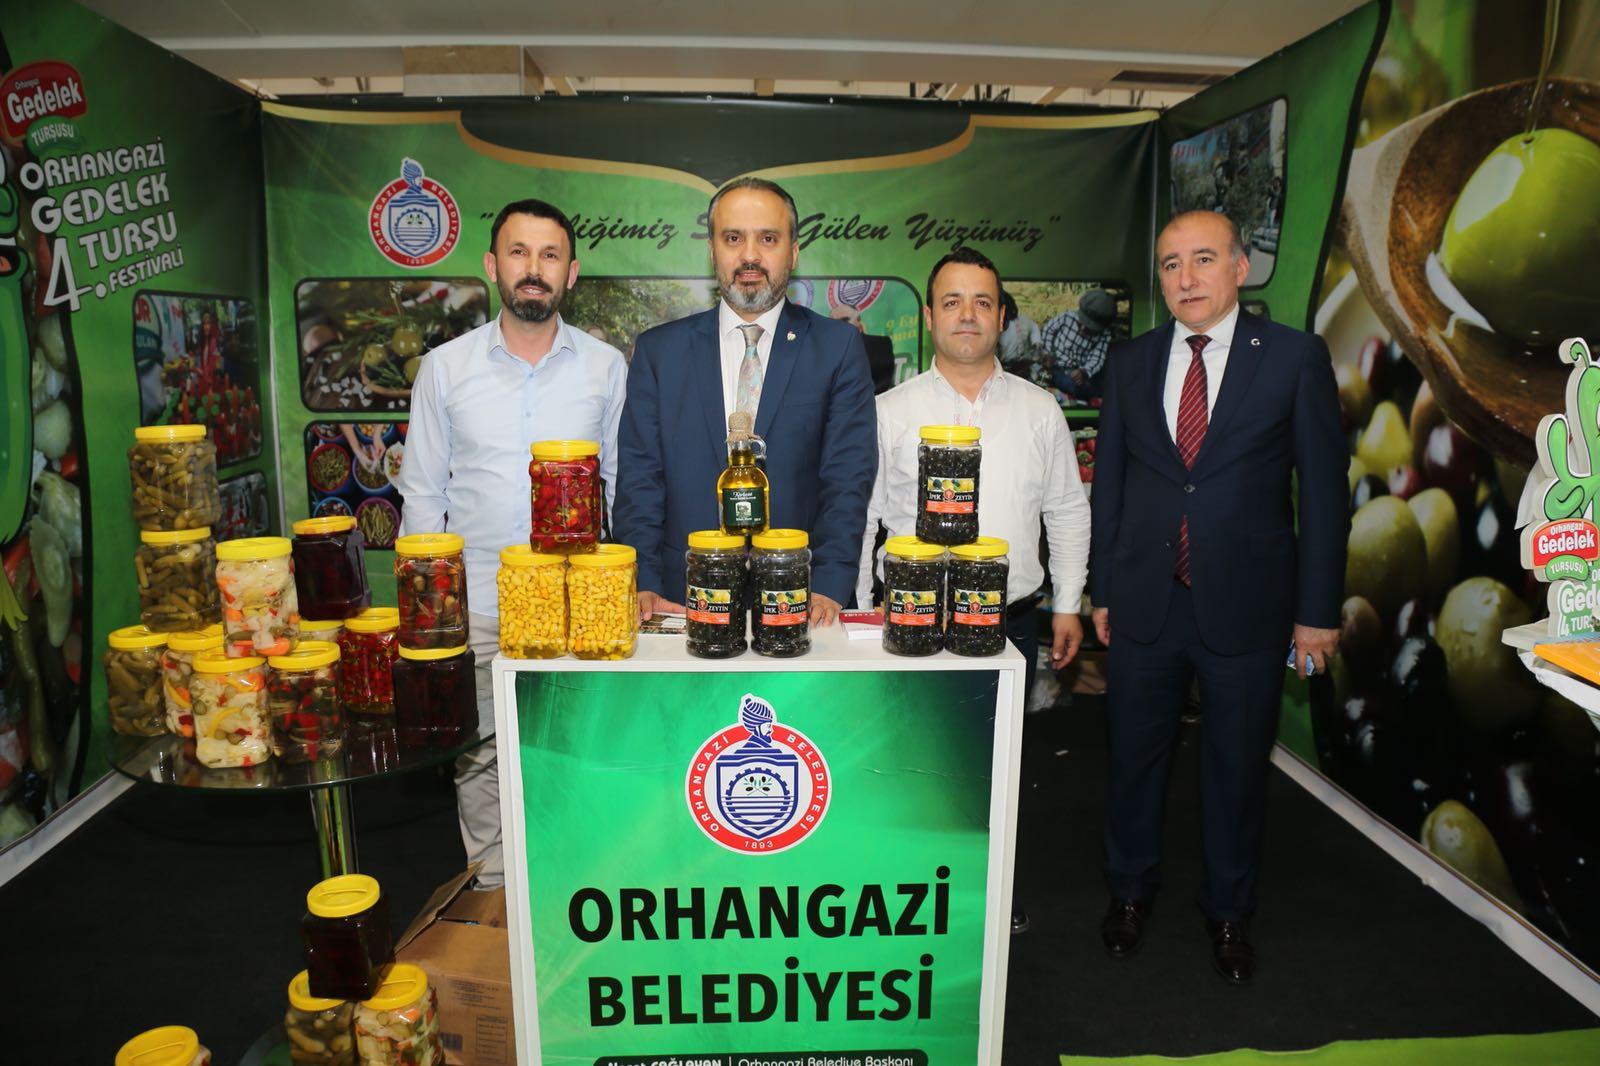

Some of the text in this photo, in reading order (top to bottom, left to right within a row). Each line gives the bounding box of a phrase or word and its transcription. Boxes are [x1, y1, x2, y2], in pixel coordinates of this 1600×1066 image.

[7, 76, 82, 124] Gedelek
[31, 123, 74, 147] TURŞUSU
[20, 137, 165, 191] ORHANGAZİ
[31, 172, 170, 234] GEDELEK
[79, 211, 178, 268] TURŞU
[797, 212, 890, 250] Gülen
[109, 244, 184, 292] FESTİVALİ
[1538, 530, 1595, 554] Gedelek
[1550, 522, 1584, 536] Orhangazi
[1551, 561, 1584, 575] TURŞUSU
[744, 841, 774, 849] 1893
[568, 865, 950, 943] ORHANGAZİ
[588, 953, 934, 1027] BELEDİYESİ
